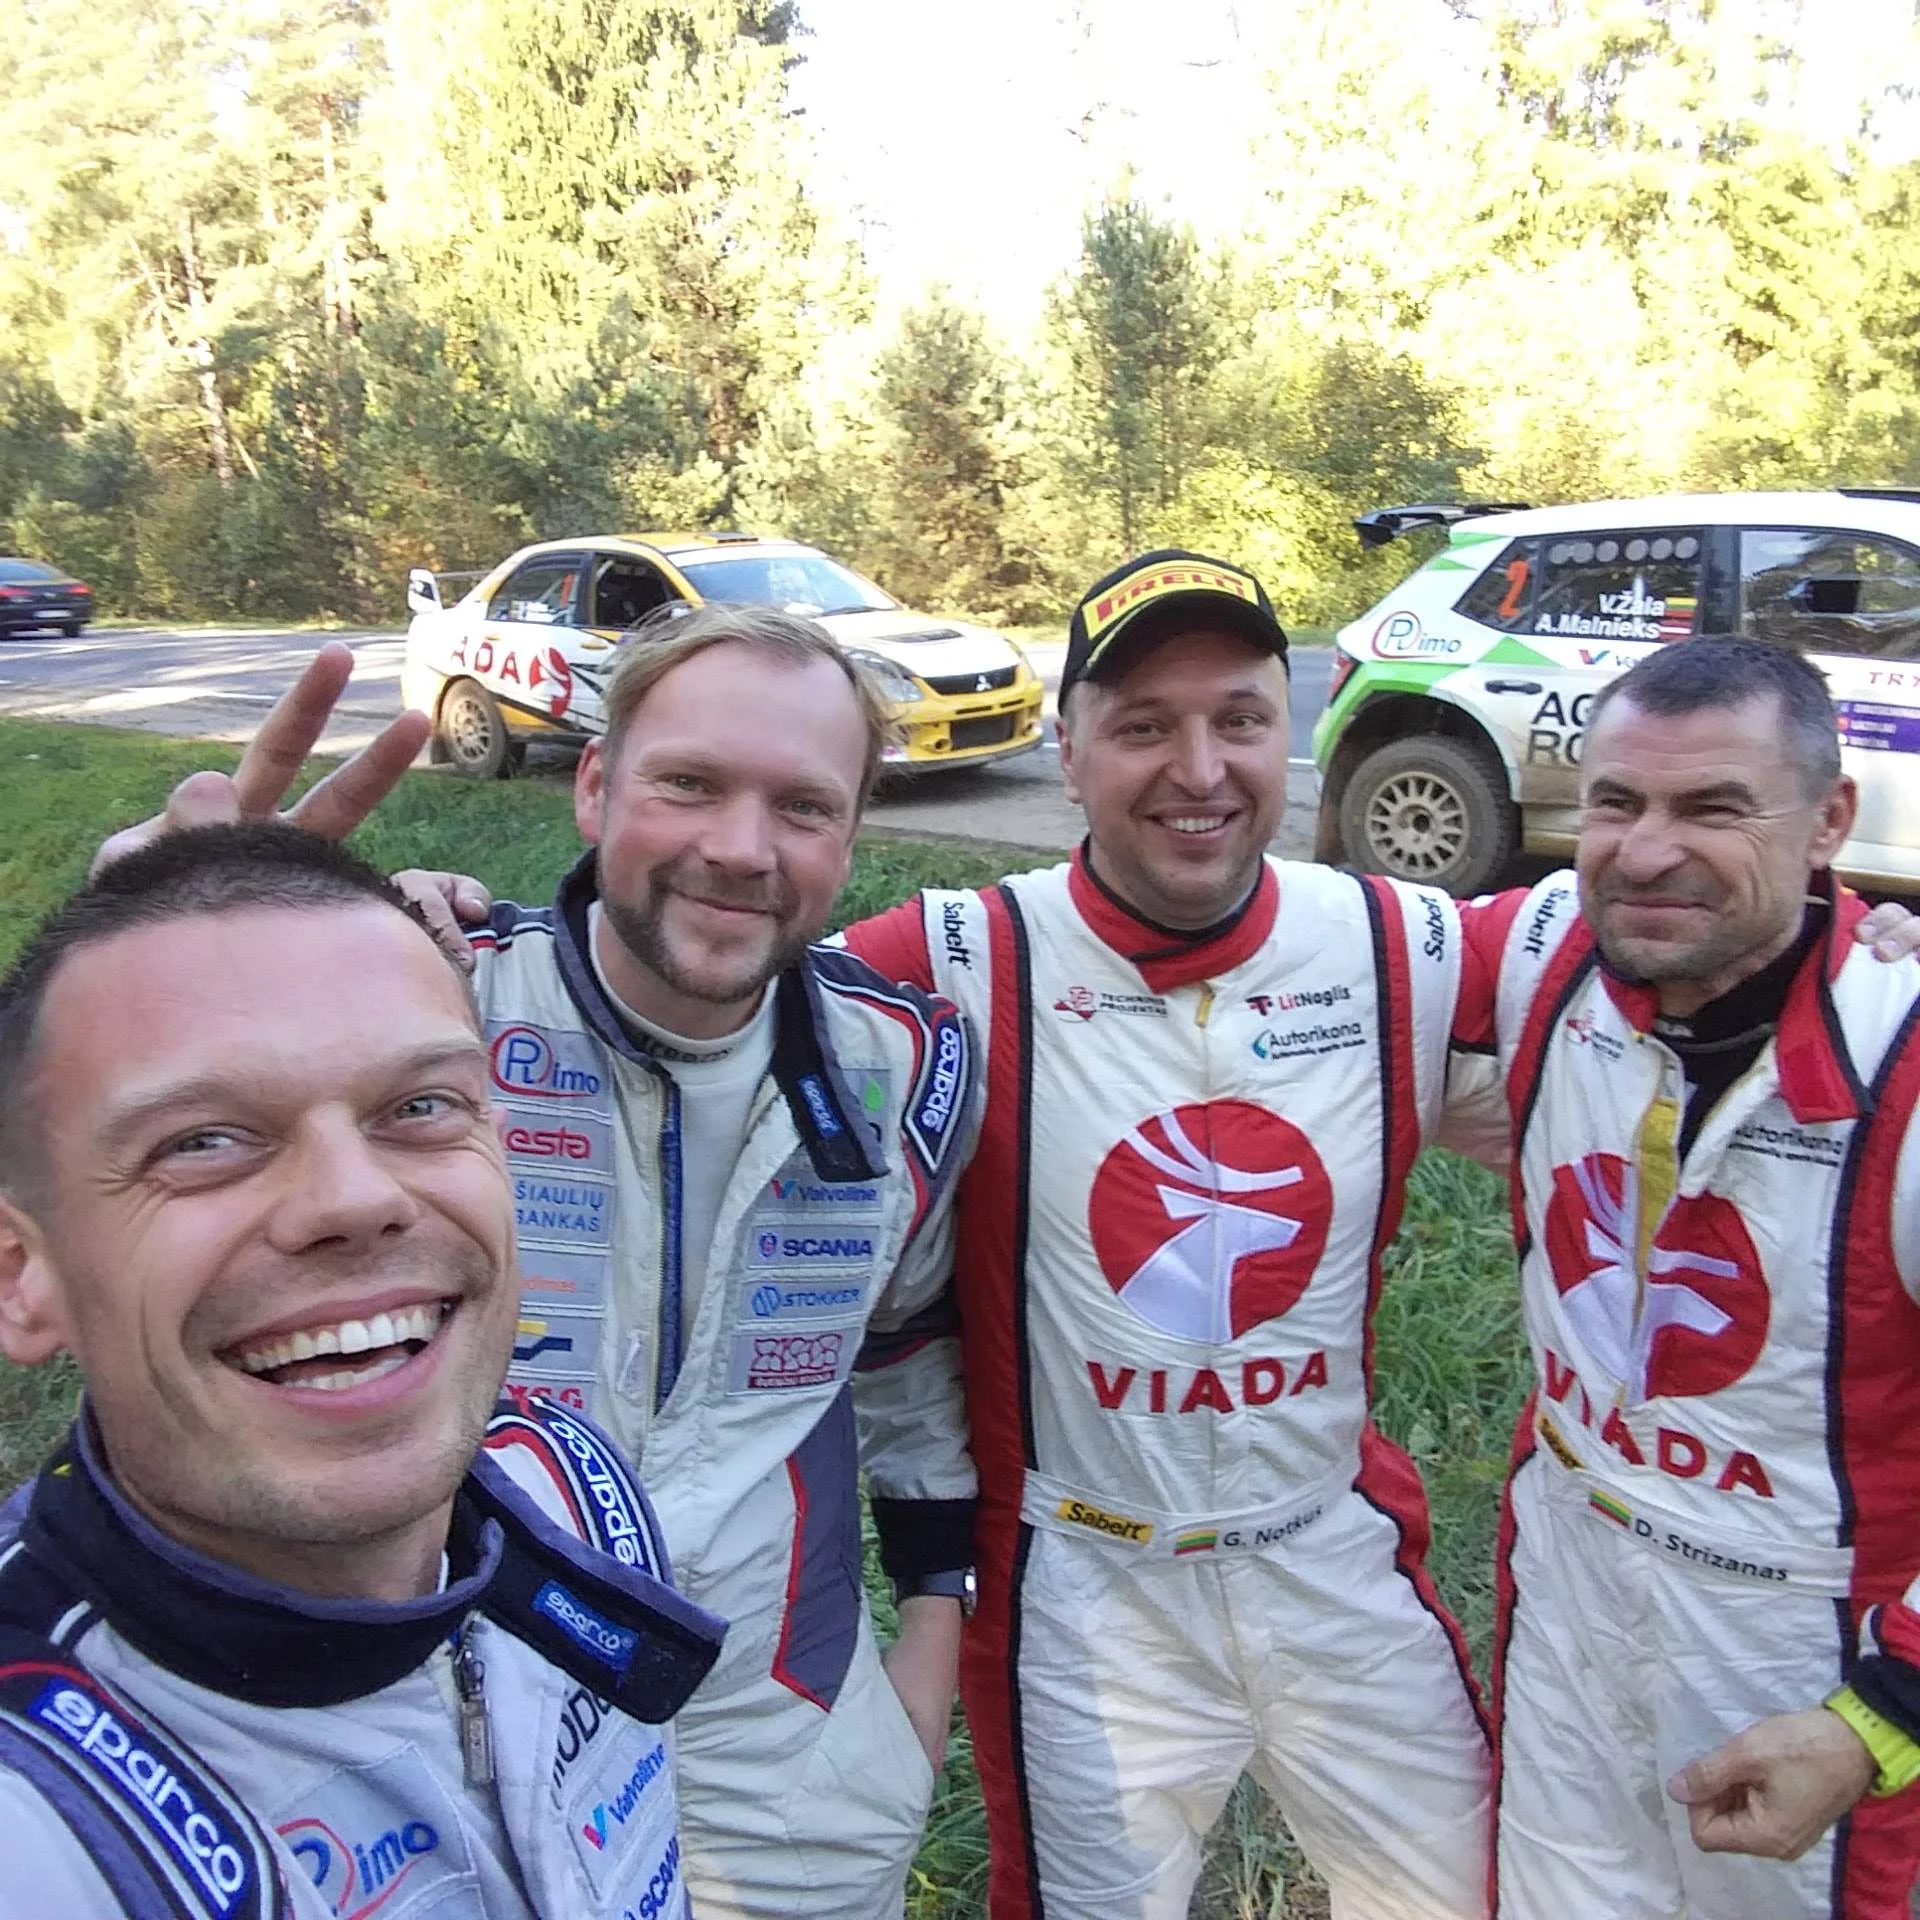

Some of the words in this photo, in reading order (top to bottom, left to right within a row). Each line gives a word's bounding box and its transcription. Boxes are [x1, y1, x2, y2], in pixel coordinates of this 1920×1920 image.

[1498, 560, 1529, 617] 2
[943, 901, 972, 970] Sabelt
[1416, 893, 1444, 962] Sabelt
[1270, 1023, 1362, 1046] Autorikona
[921, 1026, 960, 1133] sparco
[515, 1180, 605, 1211] ŠIAULIŲ
[783, 1239, 873, 1257] SCANIA
[782, 1289, 860, 1307] STOKKER
[1086, 1350, 1328, 1413] VIADA
[549, 1420, 638, 1566] sparco
[1067, 1502, 1145, 1540] Sabelt
[1224, 1532, 1247, 1547] G.
[1635, 1519, 1659, 1544] D.
[1665, 1534, 1789, 1581] Strizanas
[547, 1592, 622, 1655] sparco
[50, 1690, 244, 1895] sparco
